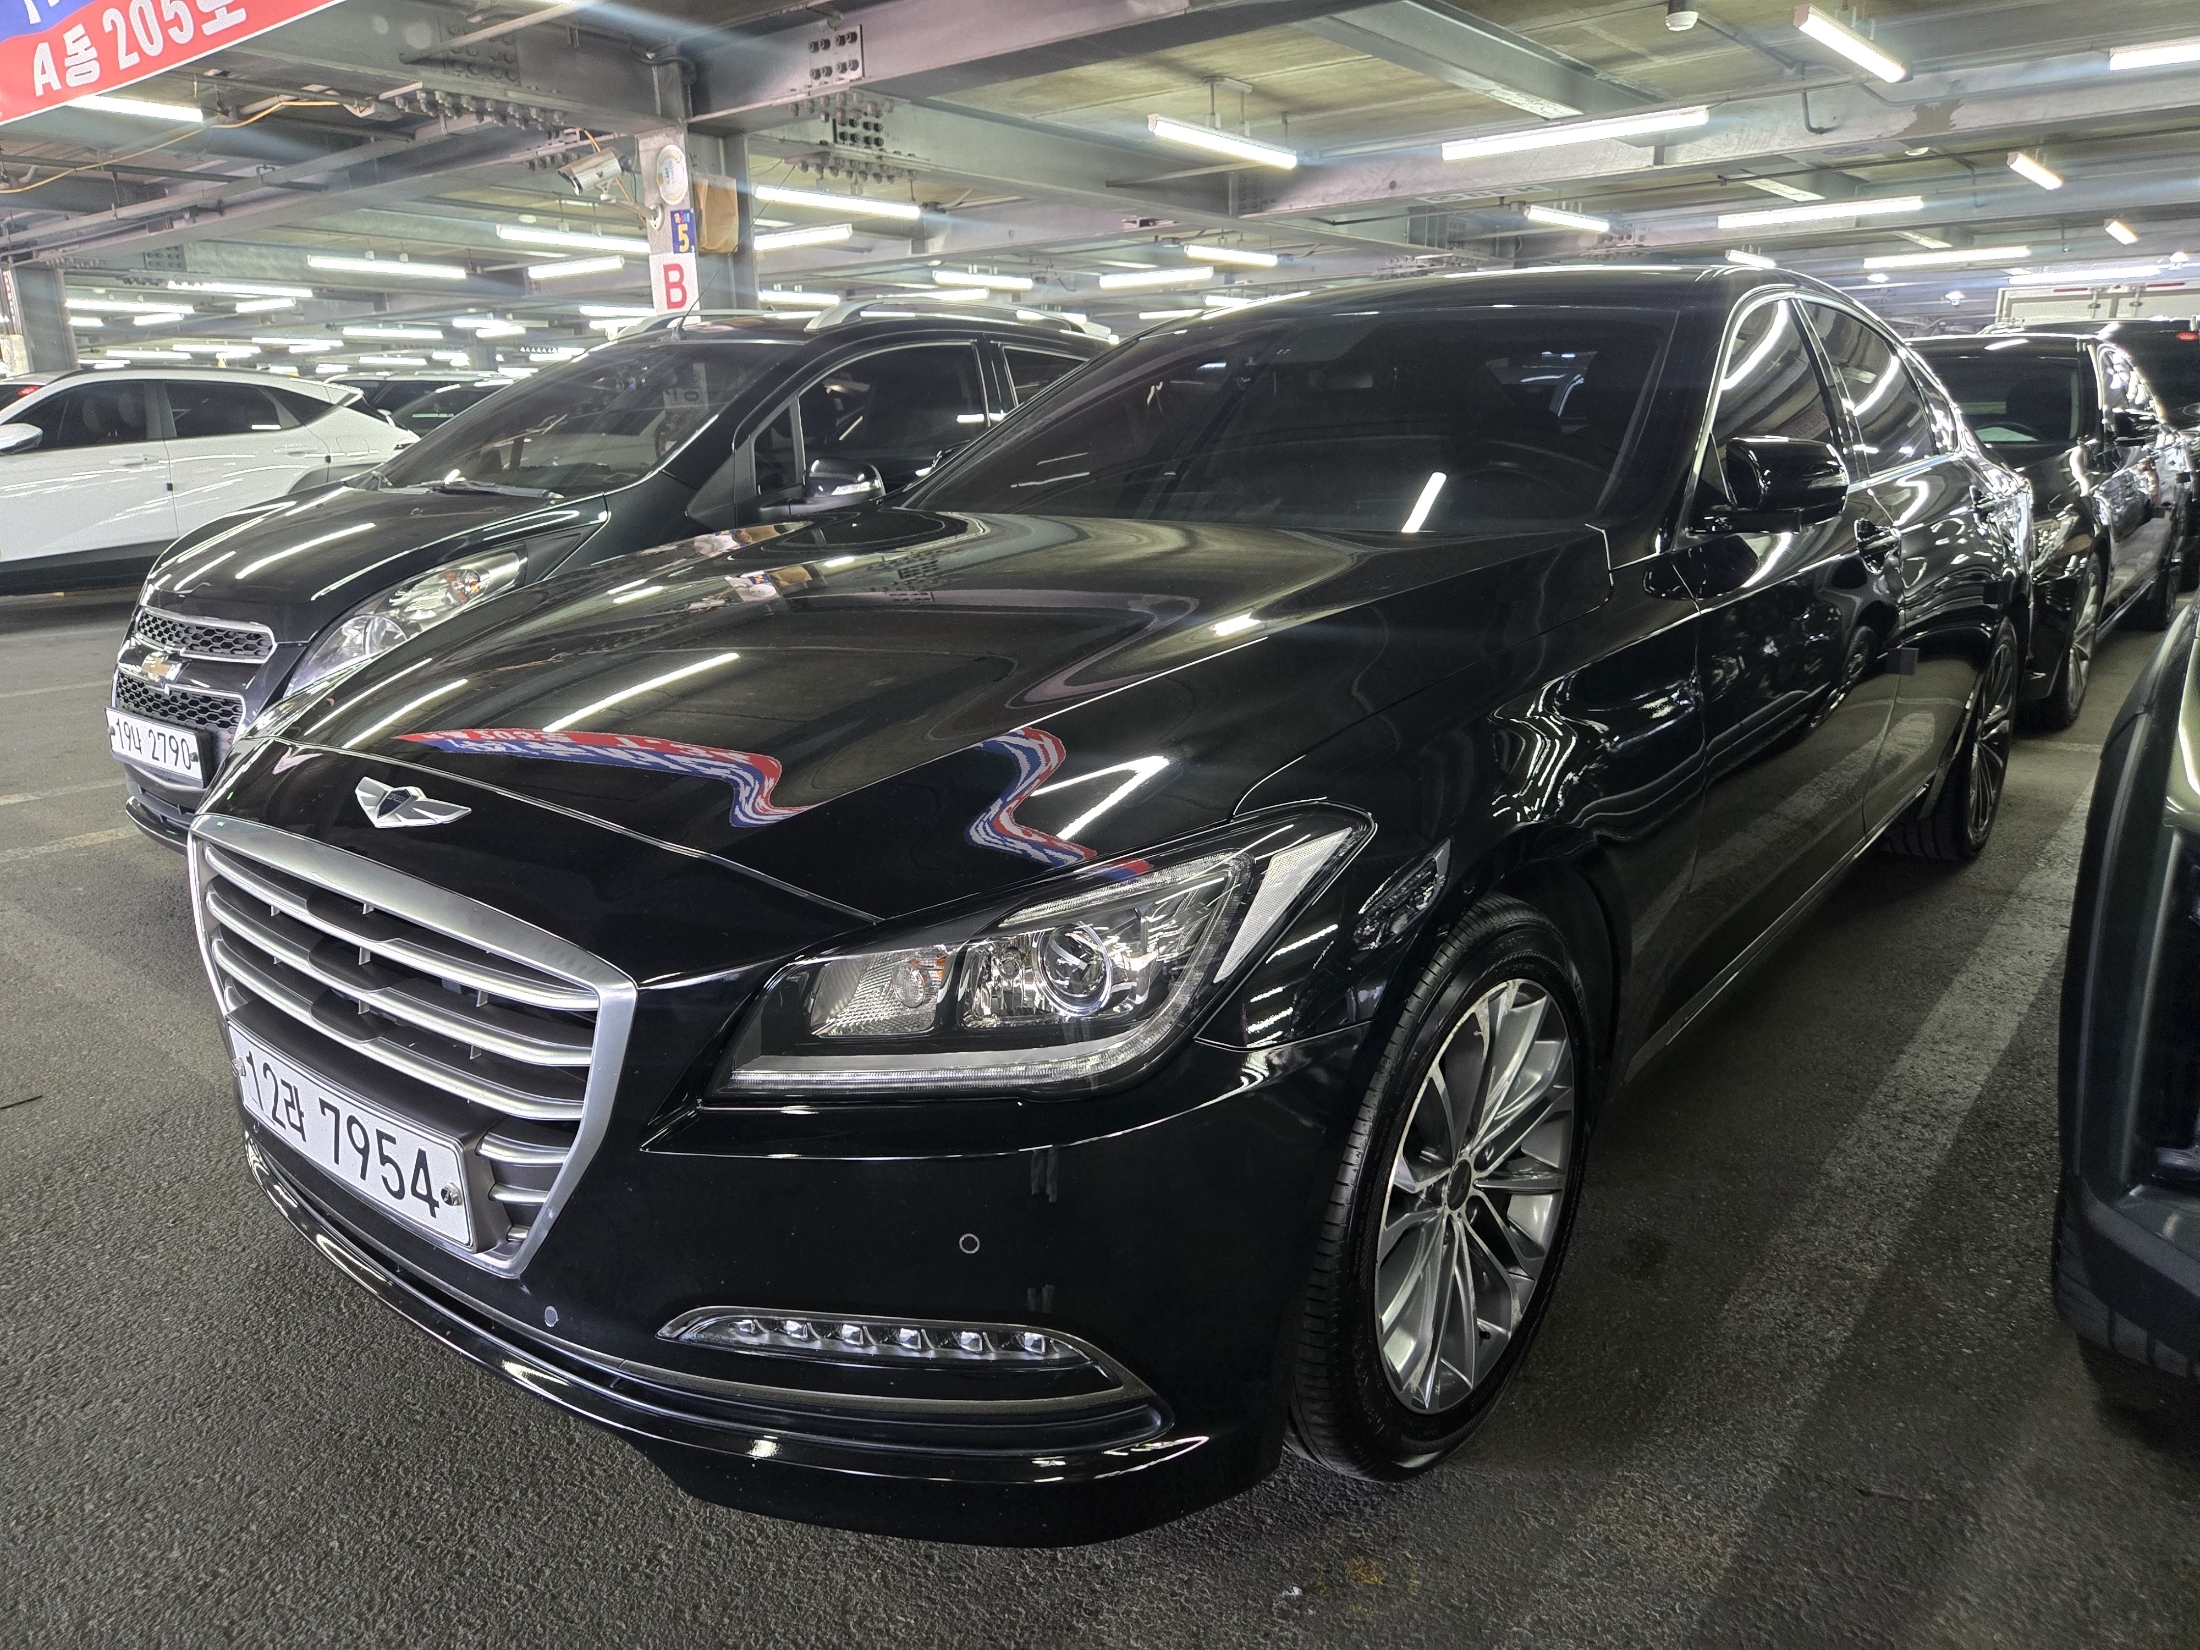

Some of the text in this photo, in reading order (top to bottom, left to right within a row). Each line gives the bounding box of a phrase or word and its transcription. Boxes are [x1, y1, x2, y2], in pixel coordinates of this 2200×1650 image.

[33, 23, 101, 97] A동
[677, 223, 690, 253] 5
[663, 263, 687, 310] B
[116, 717, 192, 770] 19나 2790
[246, 1050, 440, 1219] 12라 7954
